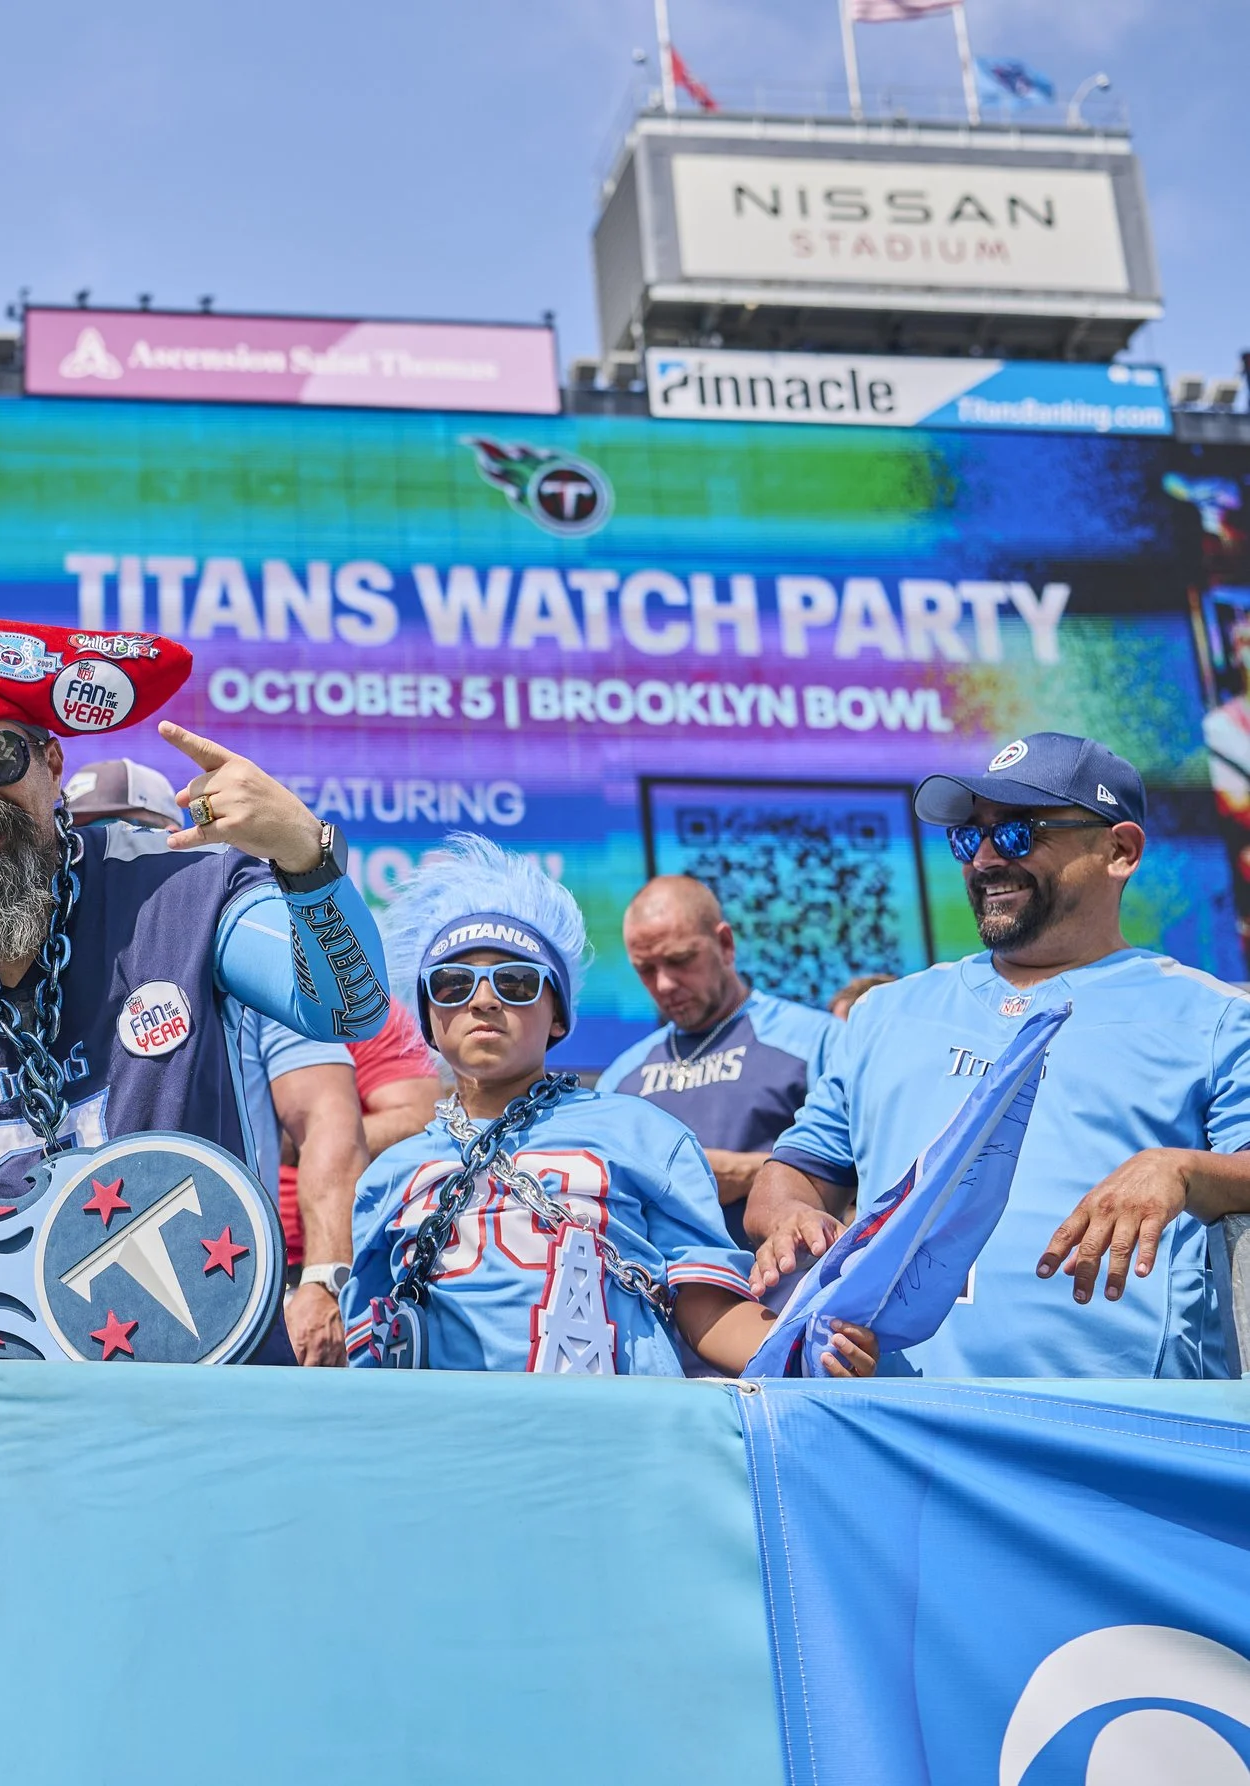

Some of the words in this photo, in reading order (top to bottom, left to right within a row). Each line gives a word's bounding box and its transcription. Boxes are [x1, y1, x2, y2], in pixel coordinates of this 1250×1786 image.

[733, 182, 1058, 229] NISSAN
[790, 229, 1011, 265] STADIUM
[128, 339, 284, 374] Ascension
[290, 343, 369, 376] Saint
[375, 349, 499, 381] Thomas
[658, 360, 895, 412] Pinnacle
[64, 553, 399, 645] TITANS
[412, 563, 763, 658] WATCH
[775, 575, 1071, 664] PARTY
[66, 679, 107, 707] FAN
[105, 699, 119, 709] THE
[106, 691, 117, 700] OF
[208, 669, 454, 720] OCTOBER
[461, 674, 491, 719] 5
[528, 674, 797, 729] BROOKLYN
[803, 685, 954, 734] BOWL
[63, 698, 115, 727] YEAR
[129, 1004, 167, 1037] FAN
[163, 1000, 173, 1012] OF
[166, 1006, 181, 1019] THE
[135, 1015, 188, 1053] YEAR
